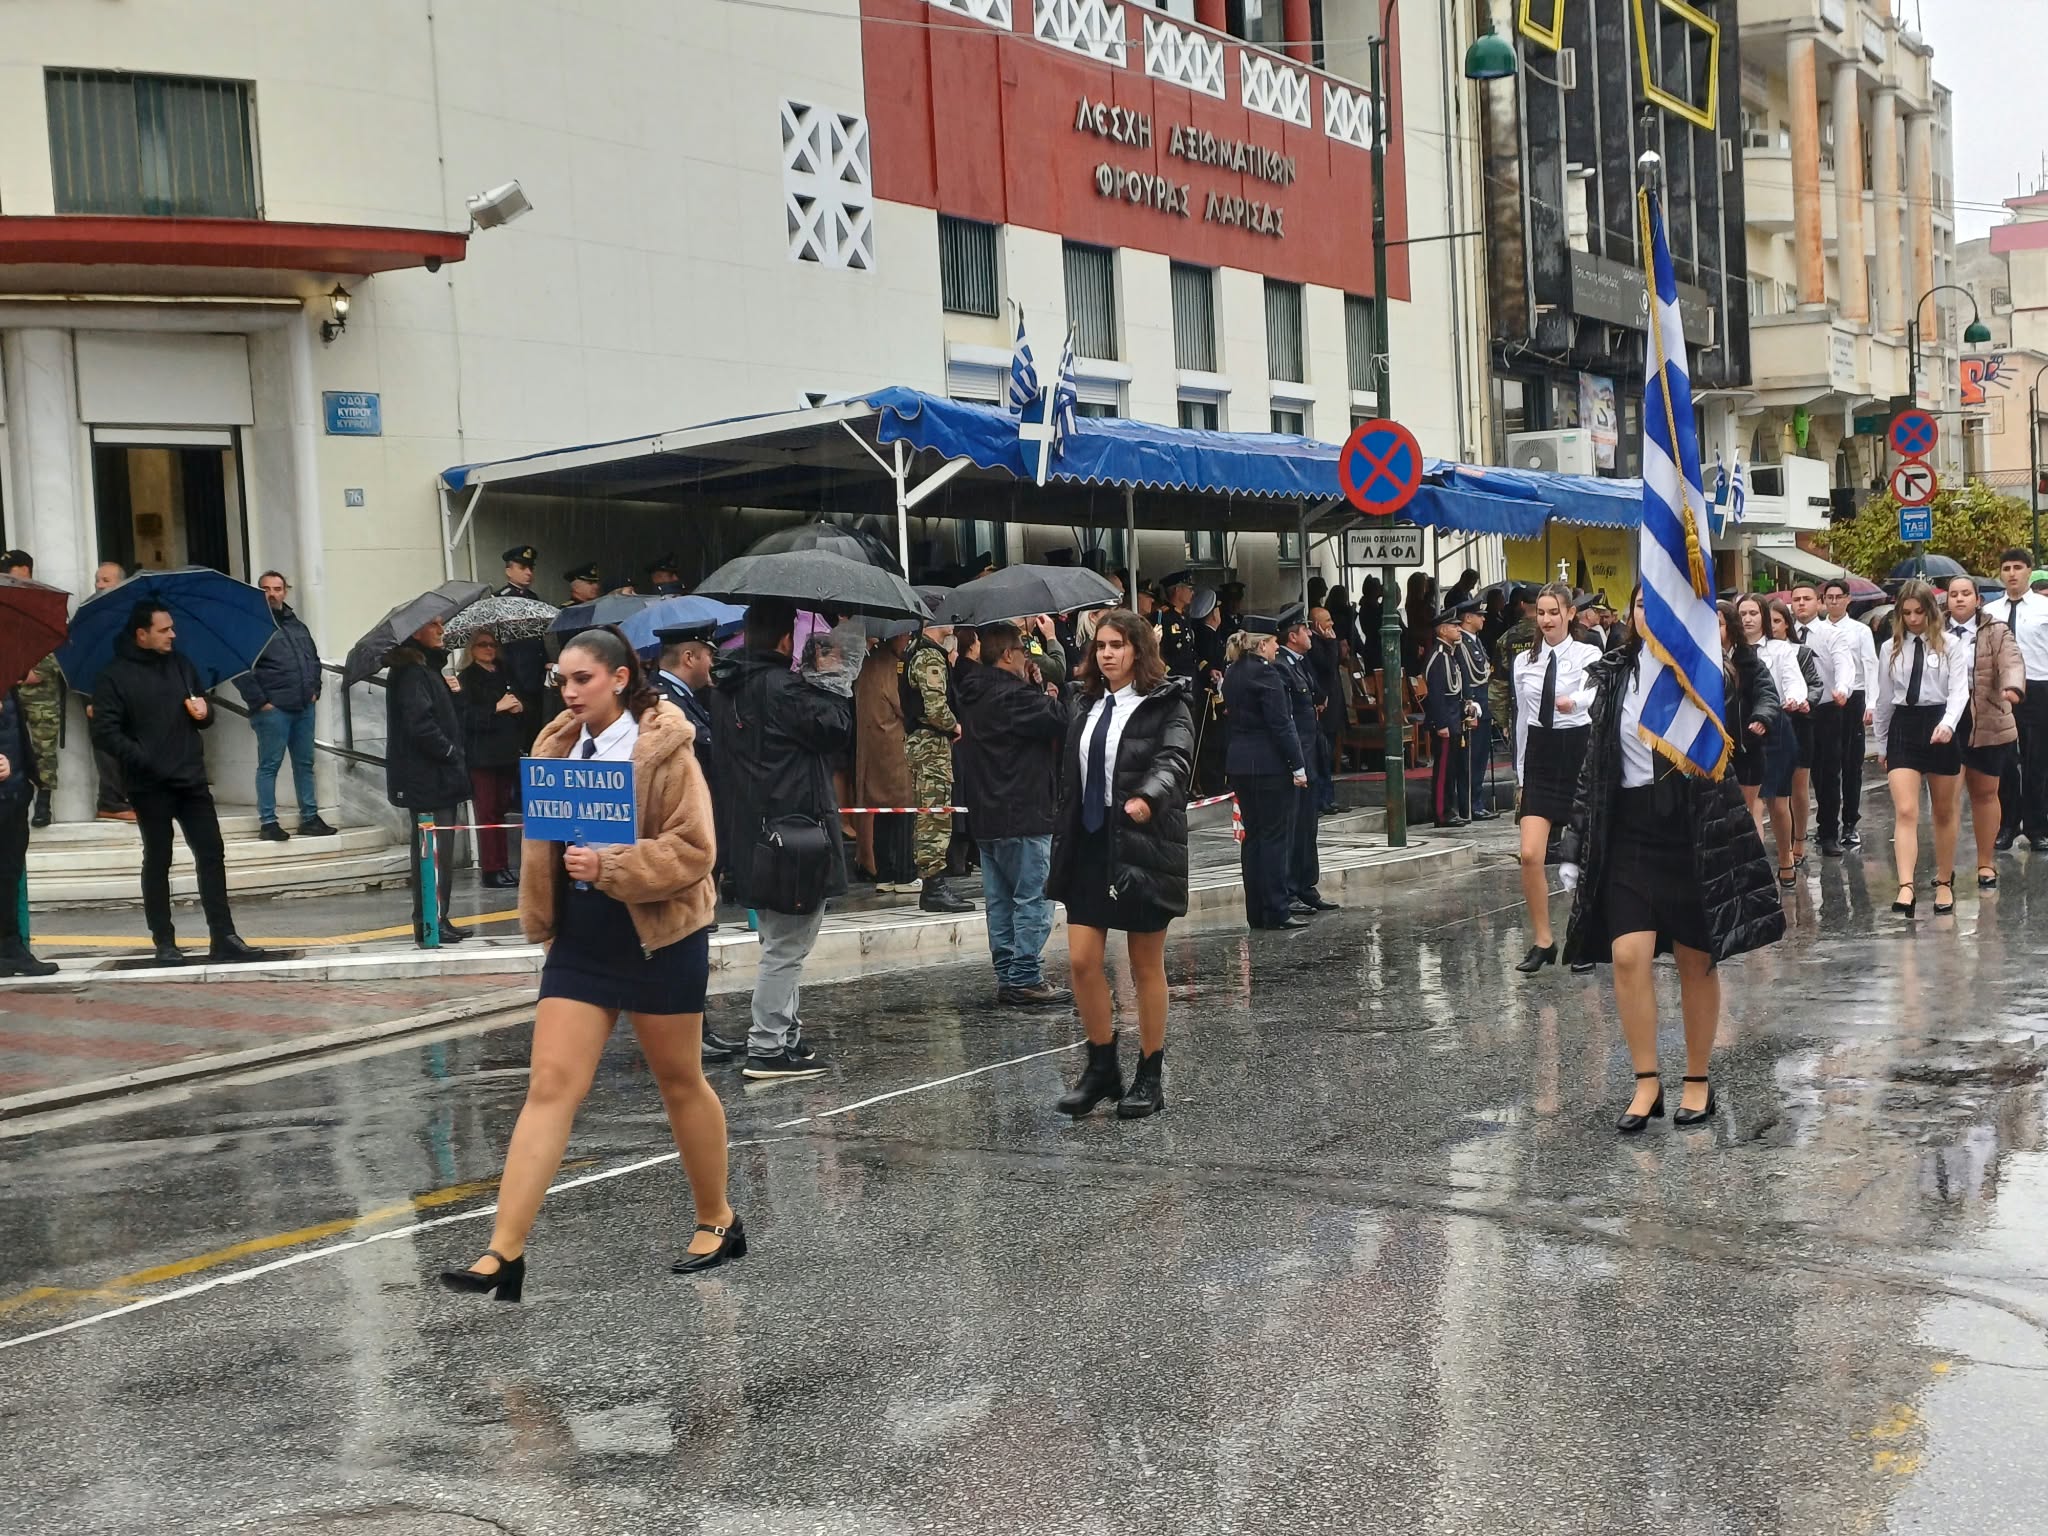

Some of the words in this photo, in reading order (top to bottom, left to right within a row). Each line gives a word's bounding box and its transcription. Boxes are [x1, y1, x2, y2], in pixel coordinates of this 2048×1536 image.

[1076, 96, 1152, 148] ΛΕΣΧΗ
[1170, 123, 1296, 186] ΑΞΙΩΜΑΤΙΚΩΝ
[1095, 161, 1191, 218] ΦΡΟΥΡΑΣ
[1204, 187, 1285, 239] ΛΑΡΙΣΑΣ
[339, 396, 368, 406] ΟΔΟΣ
[337, 407, 371, 417] ΚΥΠΡΟΥ
[348, 491, 361, 504] 76
[529, 765, 556, 787] 12ο
[563, 769, 625, 789] ΕΝΙΑΙΟ
[528, 800, 572, 818] ΛΥΚΕΙΟ
[577, 802, 631, 821] ΛΑΡΙΣΑΣ
